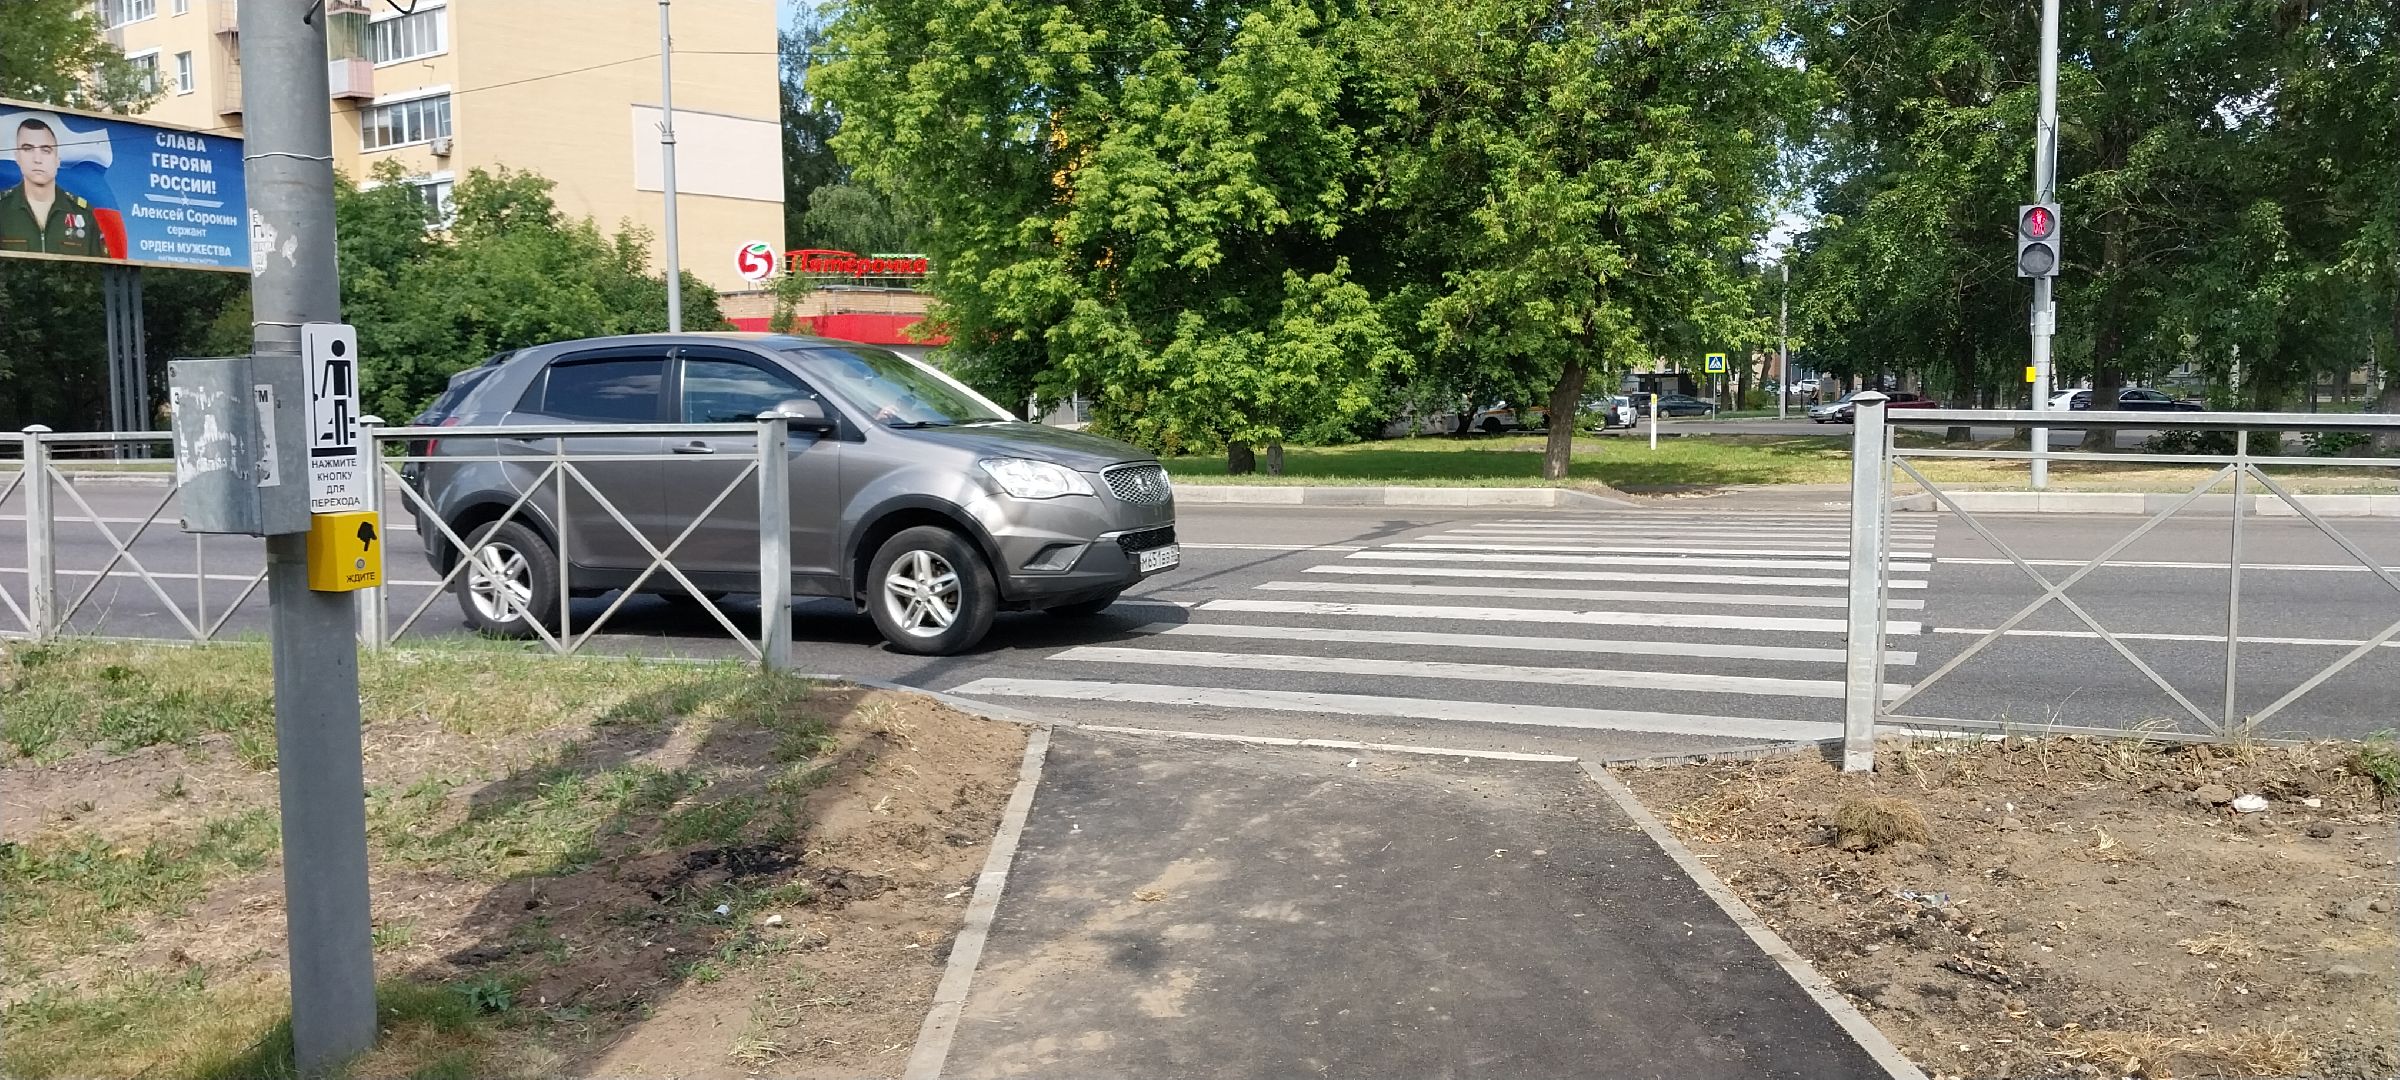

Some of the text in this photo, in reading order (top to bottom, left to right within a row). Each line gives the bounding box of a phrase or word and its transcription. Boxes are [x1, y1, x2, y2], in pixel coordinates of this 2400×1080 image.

[156, 132, 207, 153] СЛАВА
[151, 152, 213, 174] ГЕРОЯМ
[150, 173, 217, 195] РОССИИ!
[131, 203, 238, 226] Алексей Сорокин
[166, 226, 208, 237] сержант
[140, 239, 232, 257] ОРДЕН МУЖЕСТВА
[311, 458, 357, 468] НАЖМИТЕ
[317, 471, 352, 481] КНОПКУ
[326, 484, 345, 495] ДЛЯ
[311, 496, 361, 508] ПЕРЕХОДА
[346, 572, 376, 583] ЖДИТЕ
